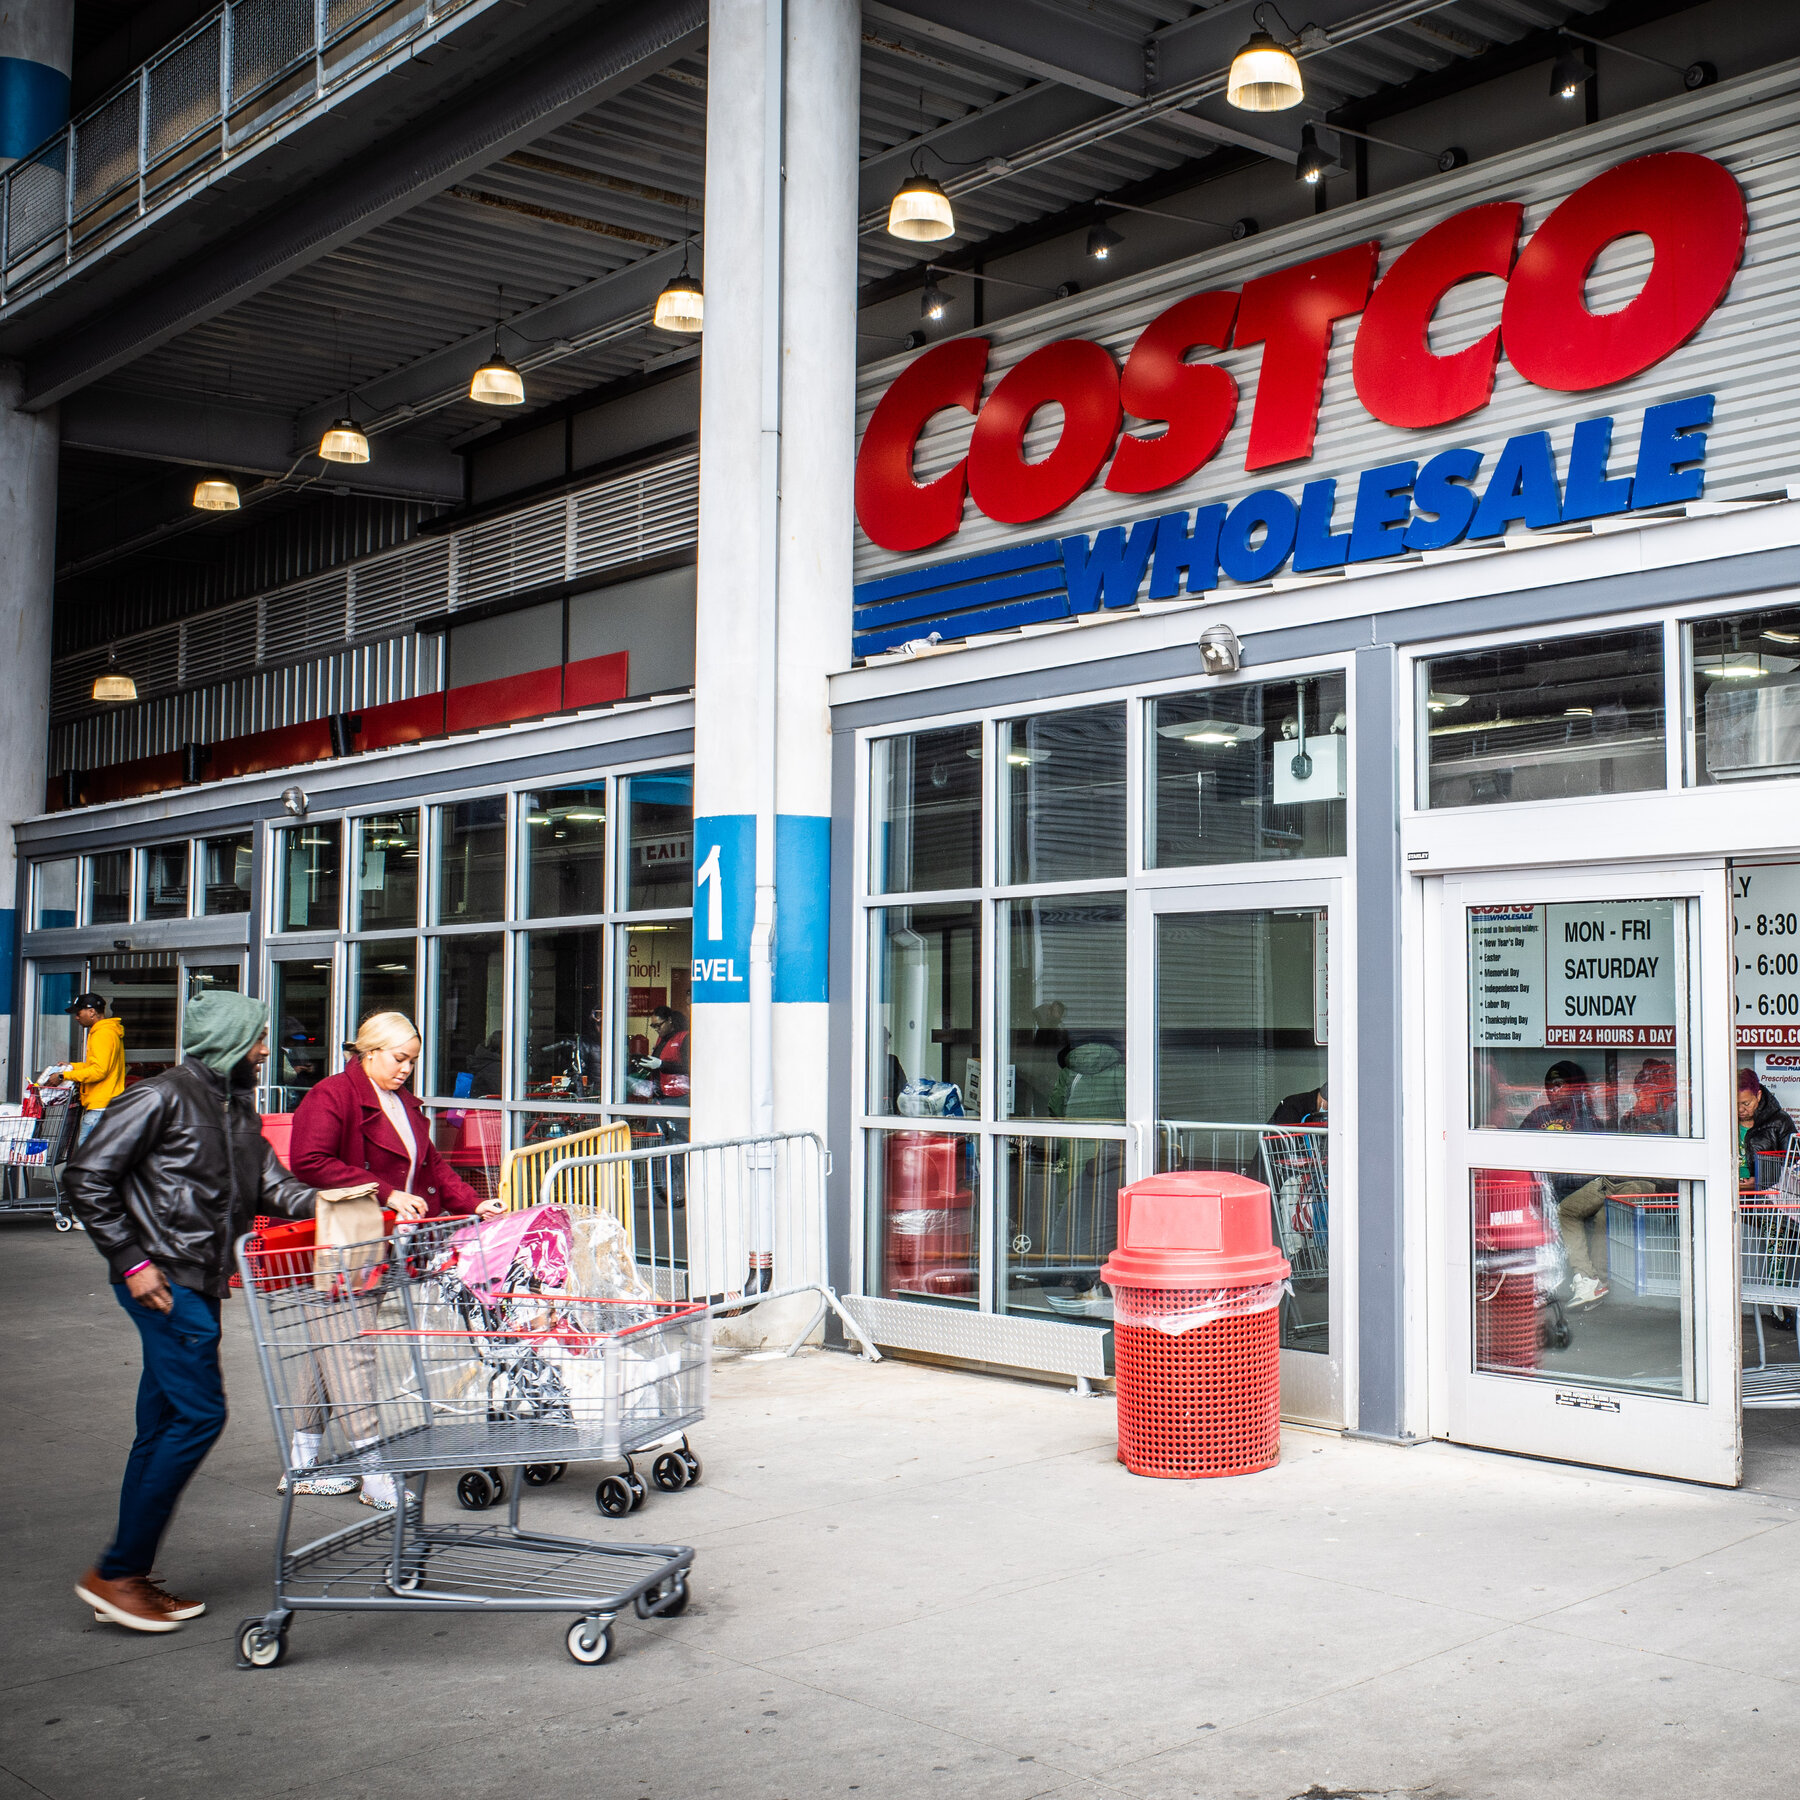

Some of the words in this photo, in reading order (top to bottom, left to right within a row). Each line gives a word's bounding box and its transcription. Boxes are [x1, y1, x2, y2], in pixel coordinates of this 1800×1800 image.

[854, 152, 1748, 552] COSTCO
[1062, 394, 1716, 614] WHOLESALE
[697, 845, 723, 941] 1
[1489, 913, 1533, 921] WHOLESALE
[1756, 912, 1798, 936] 8:30
[1565, 921, 1605, 942] MON
[1622, 919, 1651, 940] FRI
[1484, 938, 1496, 947] New
[1497, 937, 1514, 947] Year's
[1515, 937, 1525, 947] Day
[1484, 953, 1501, 962] Easter
[1757, 953, 1798, 975] 6:00
[691, 959, 743, 982] LEVEL
[1484, 968, 1509, 977] Memorial
[1510, 968, 1520, 978] Day
[1565, 957, 1659, 980] SATURDAY
[1484, 984, 1519, 994] Independence
[1520, 984, 1530, 993] Day
[1484, 1000, 1499, 1009] Labor
[1501, 1000, 1510, 1010] Day
[1565, 995, 1637, 1017] SUNDAY
[1758, 993, 1799, 1015] 6:00
[1485, 1016, 1518, 1026] Thanksgiving
[1518, 1015, 1528, 1026] Day
[1485, 1031, 1511, 1040] Christmas
[1512, 1031, 1522, 1042] Day
[1547, 1029, 1576, 1043] OPEN
[1579, 1029, 1593, 1043] 24
[1596, 1028, 1634, 1043] HOURS
[1637, 1029, 1646, 1043] A
[1649, 1028, 1673, 1043] DAY
[1736, 1028, 1800, 1044] COSTCO.C
[1765, 1053, 1800, 1066] COST
